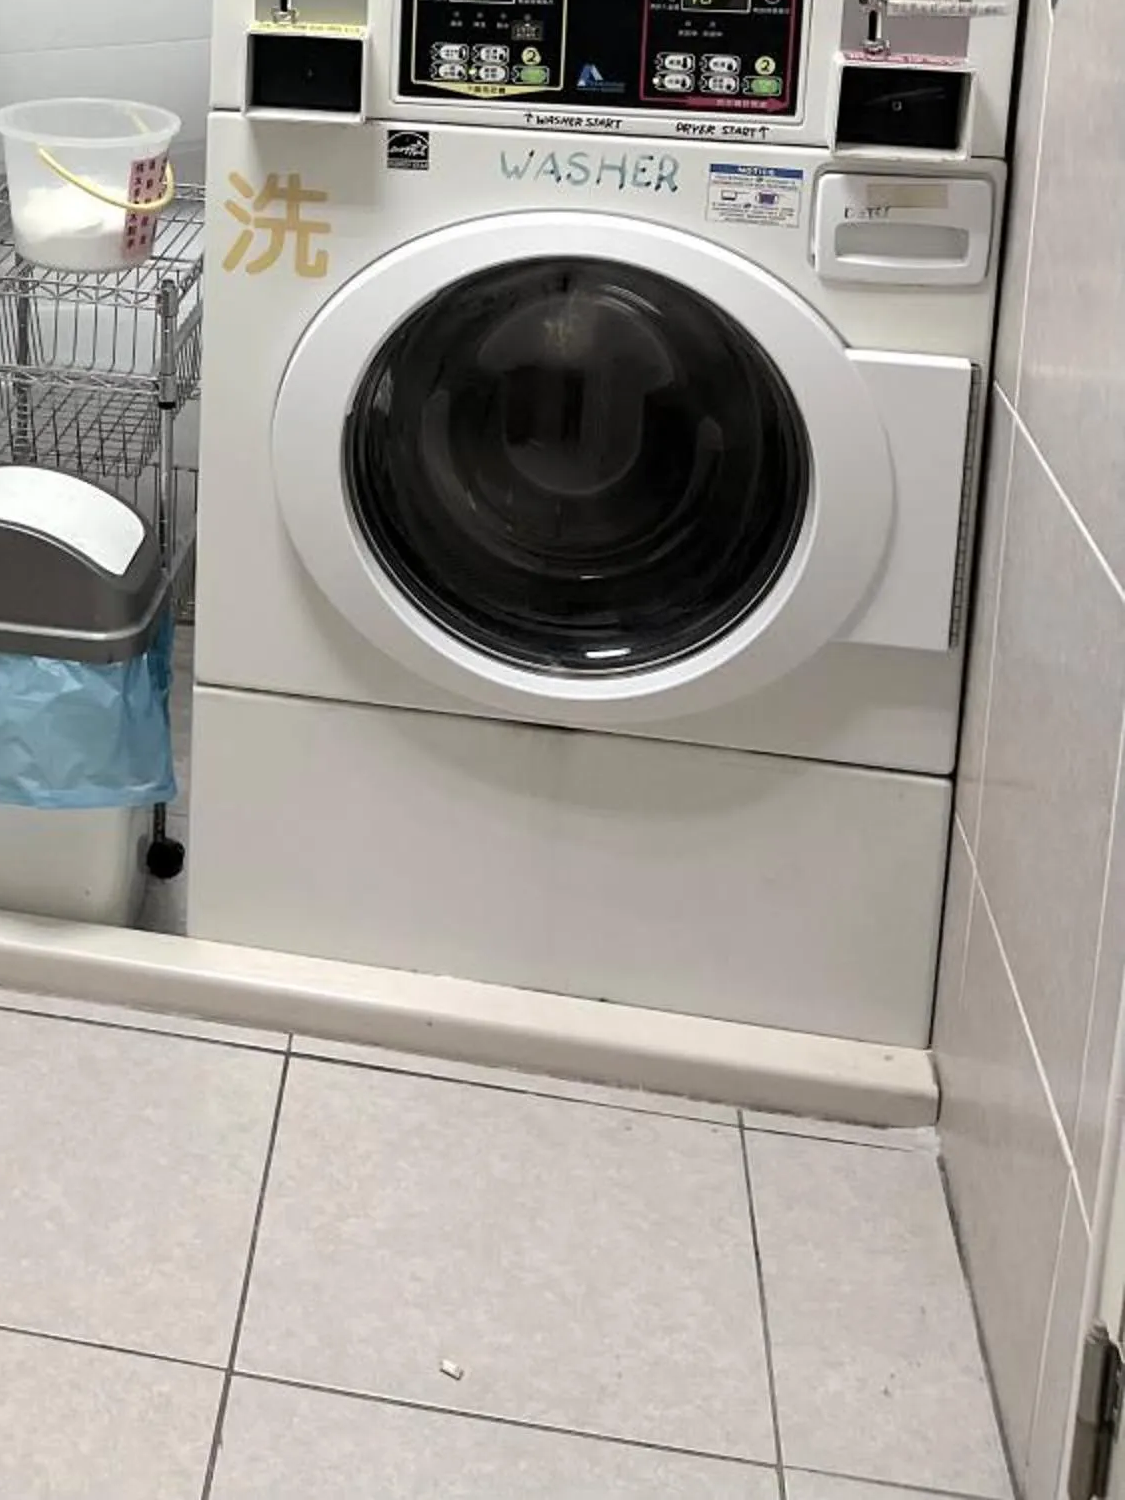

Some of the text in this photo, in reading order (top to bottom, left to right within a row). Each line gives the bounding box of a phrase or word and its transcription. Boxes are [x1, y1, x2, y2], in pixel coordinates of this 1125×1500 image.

[536, 115, 623, 129] WASHER START
[675, 121, 758, 138] DRYER START
[500, 149, 679, 192] WASHER
[222, 172, 332, 281] 洗
